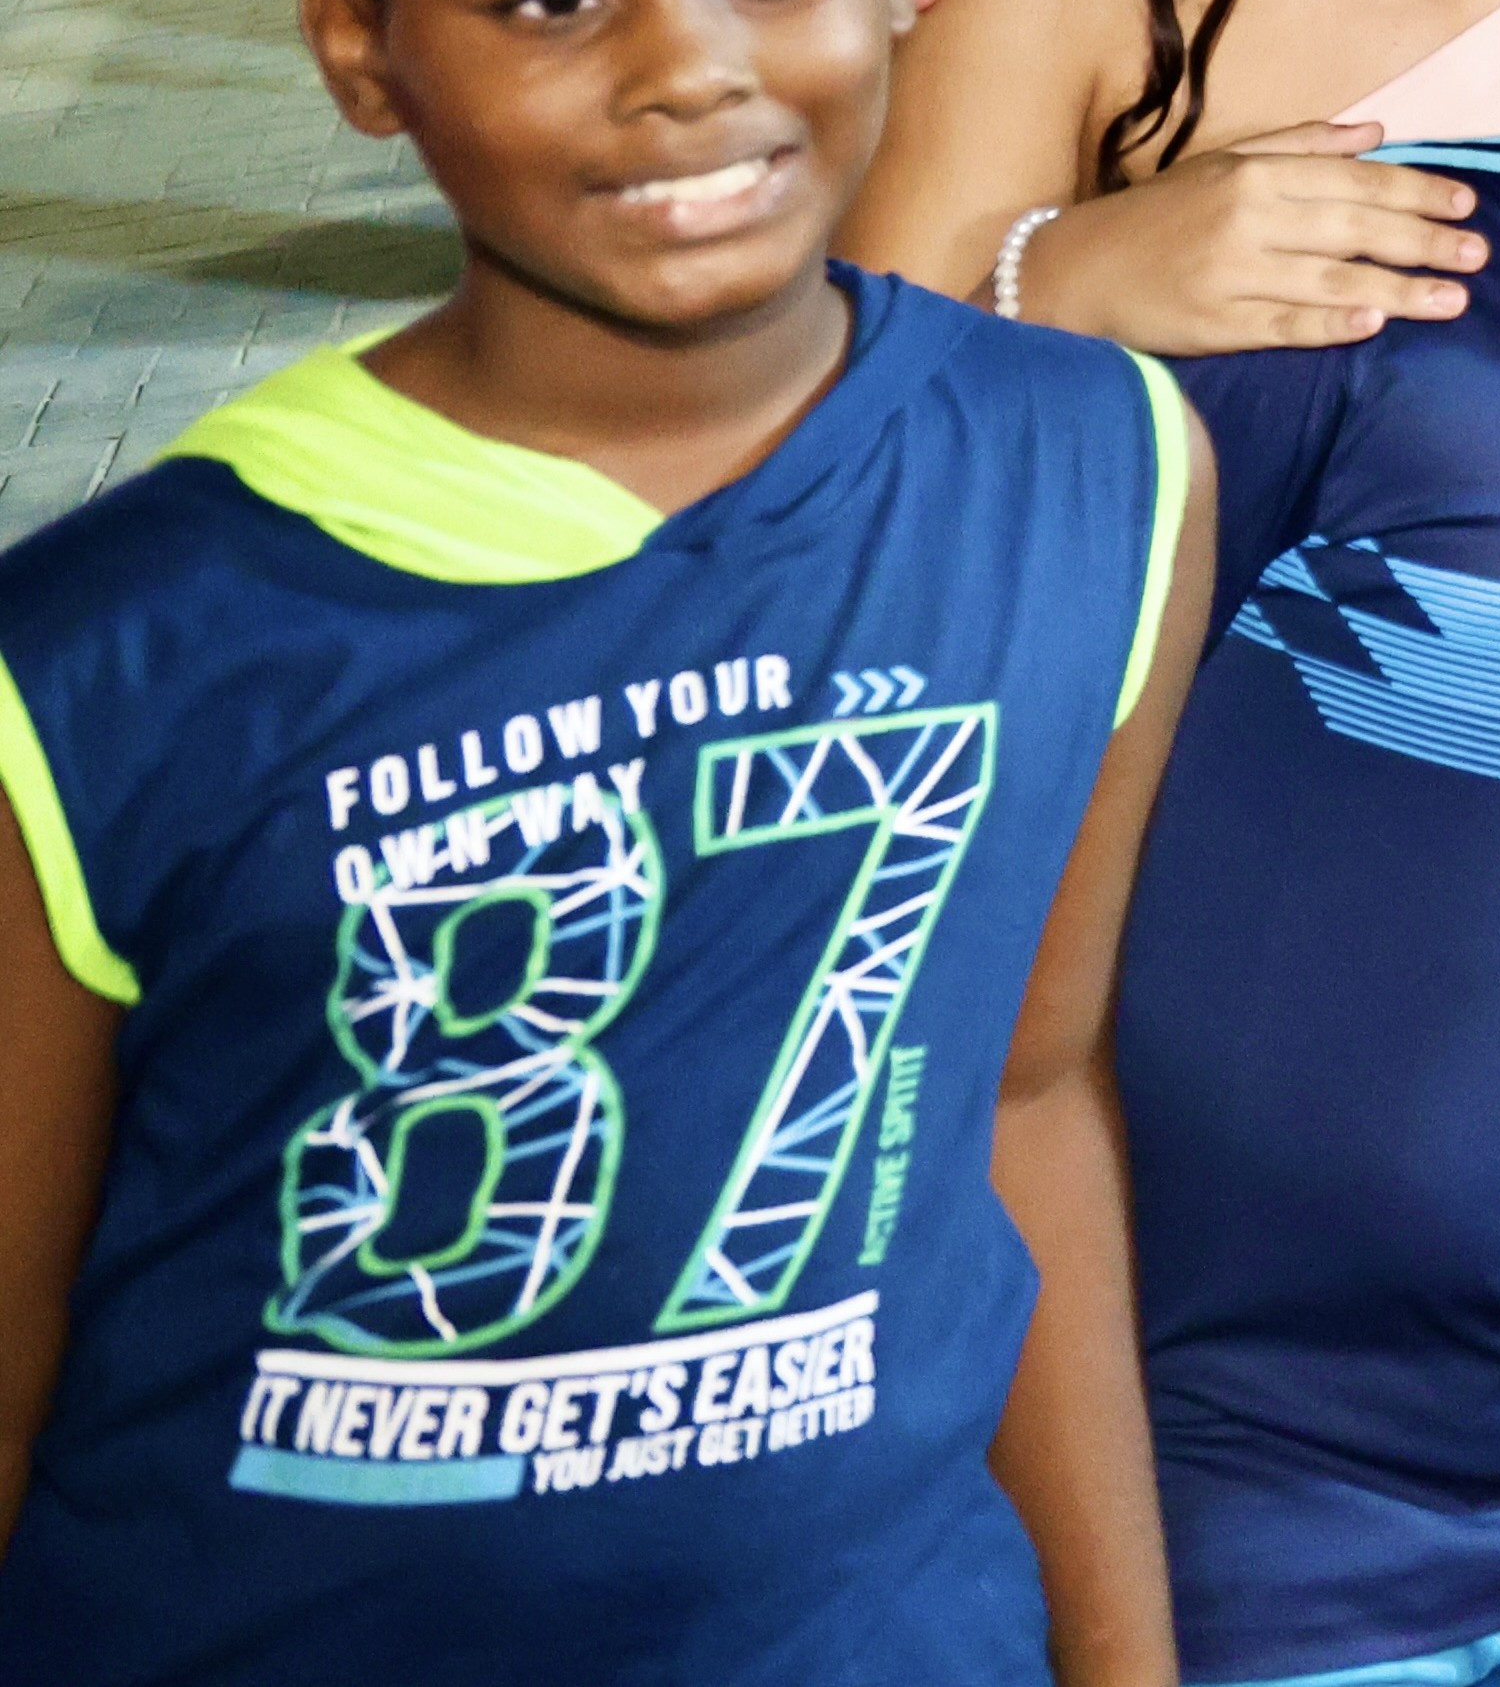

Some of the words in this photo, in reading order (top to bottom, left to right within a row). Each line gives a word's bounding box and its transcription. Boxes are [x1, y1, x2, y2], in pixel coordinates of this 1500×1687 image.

[325, 694, 602, 832] FOLLOW
[624, 653, 793, 739] YOUR
[333, 809, 491, 907] OWN
[511, 756, 646, 847] WAY
[262, 702, 998, 1358] 87
[239, 1373, 298, 1444] IT
[297, 1380, 490, 1462] NEVER
[499, 1360, 689, 1455] GET'S
[692, 1318, 877, 1425] EASIER
[533, 1447, 605, 1496] YOU
[604, 1424, 698, 1482] JUST
[699, 1415, 766, 1467] GET
